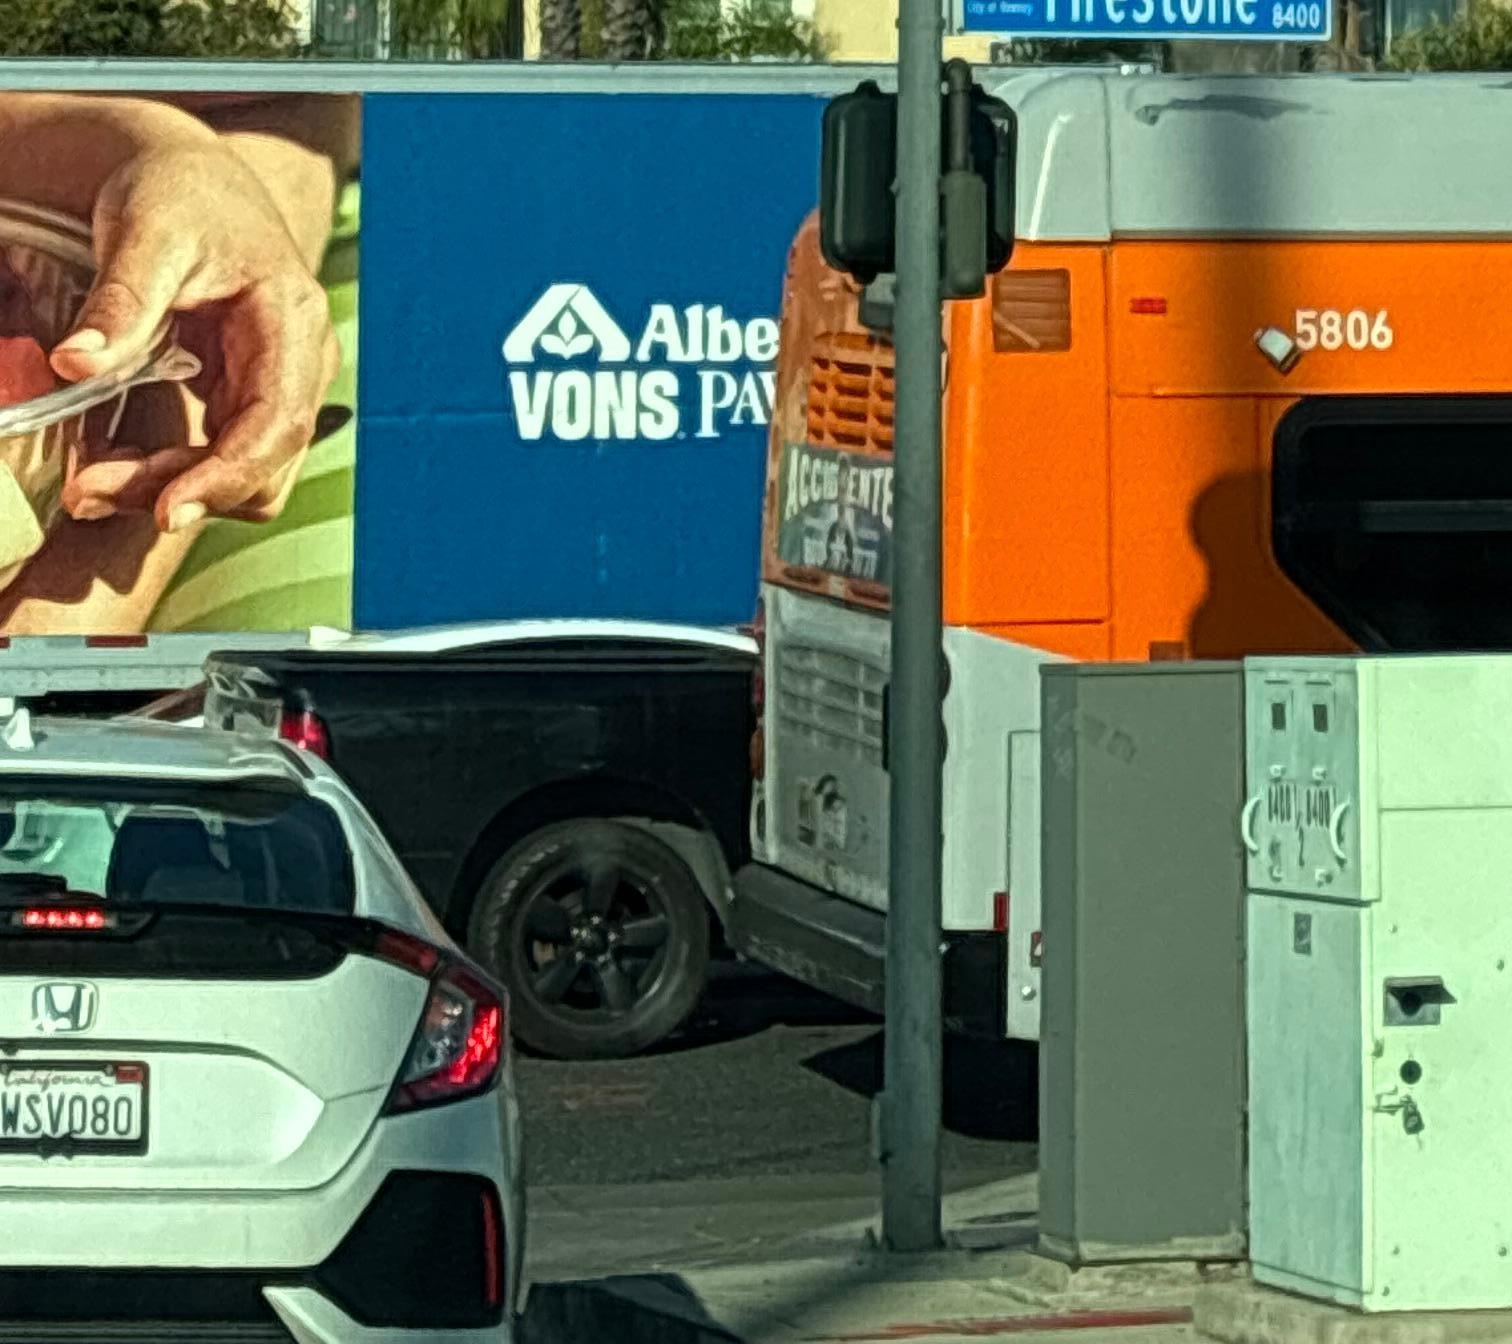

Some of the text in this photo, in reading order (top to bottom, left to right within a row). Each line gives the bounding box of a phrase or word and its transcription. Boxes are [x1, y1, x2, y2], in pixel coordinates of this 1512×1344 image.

[1272, 2, 1320, 29] 8400
[1295, 310, 1393, 350] 5806
[509, 370, 680, 441] VONS
